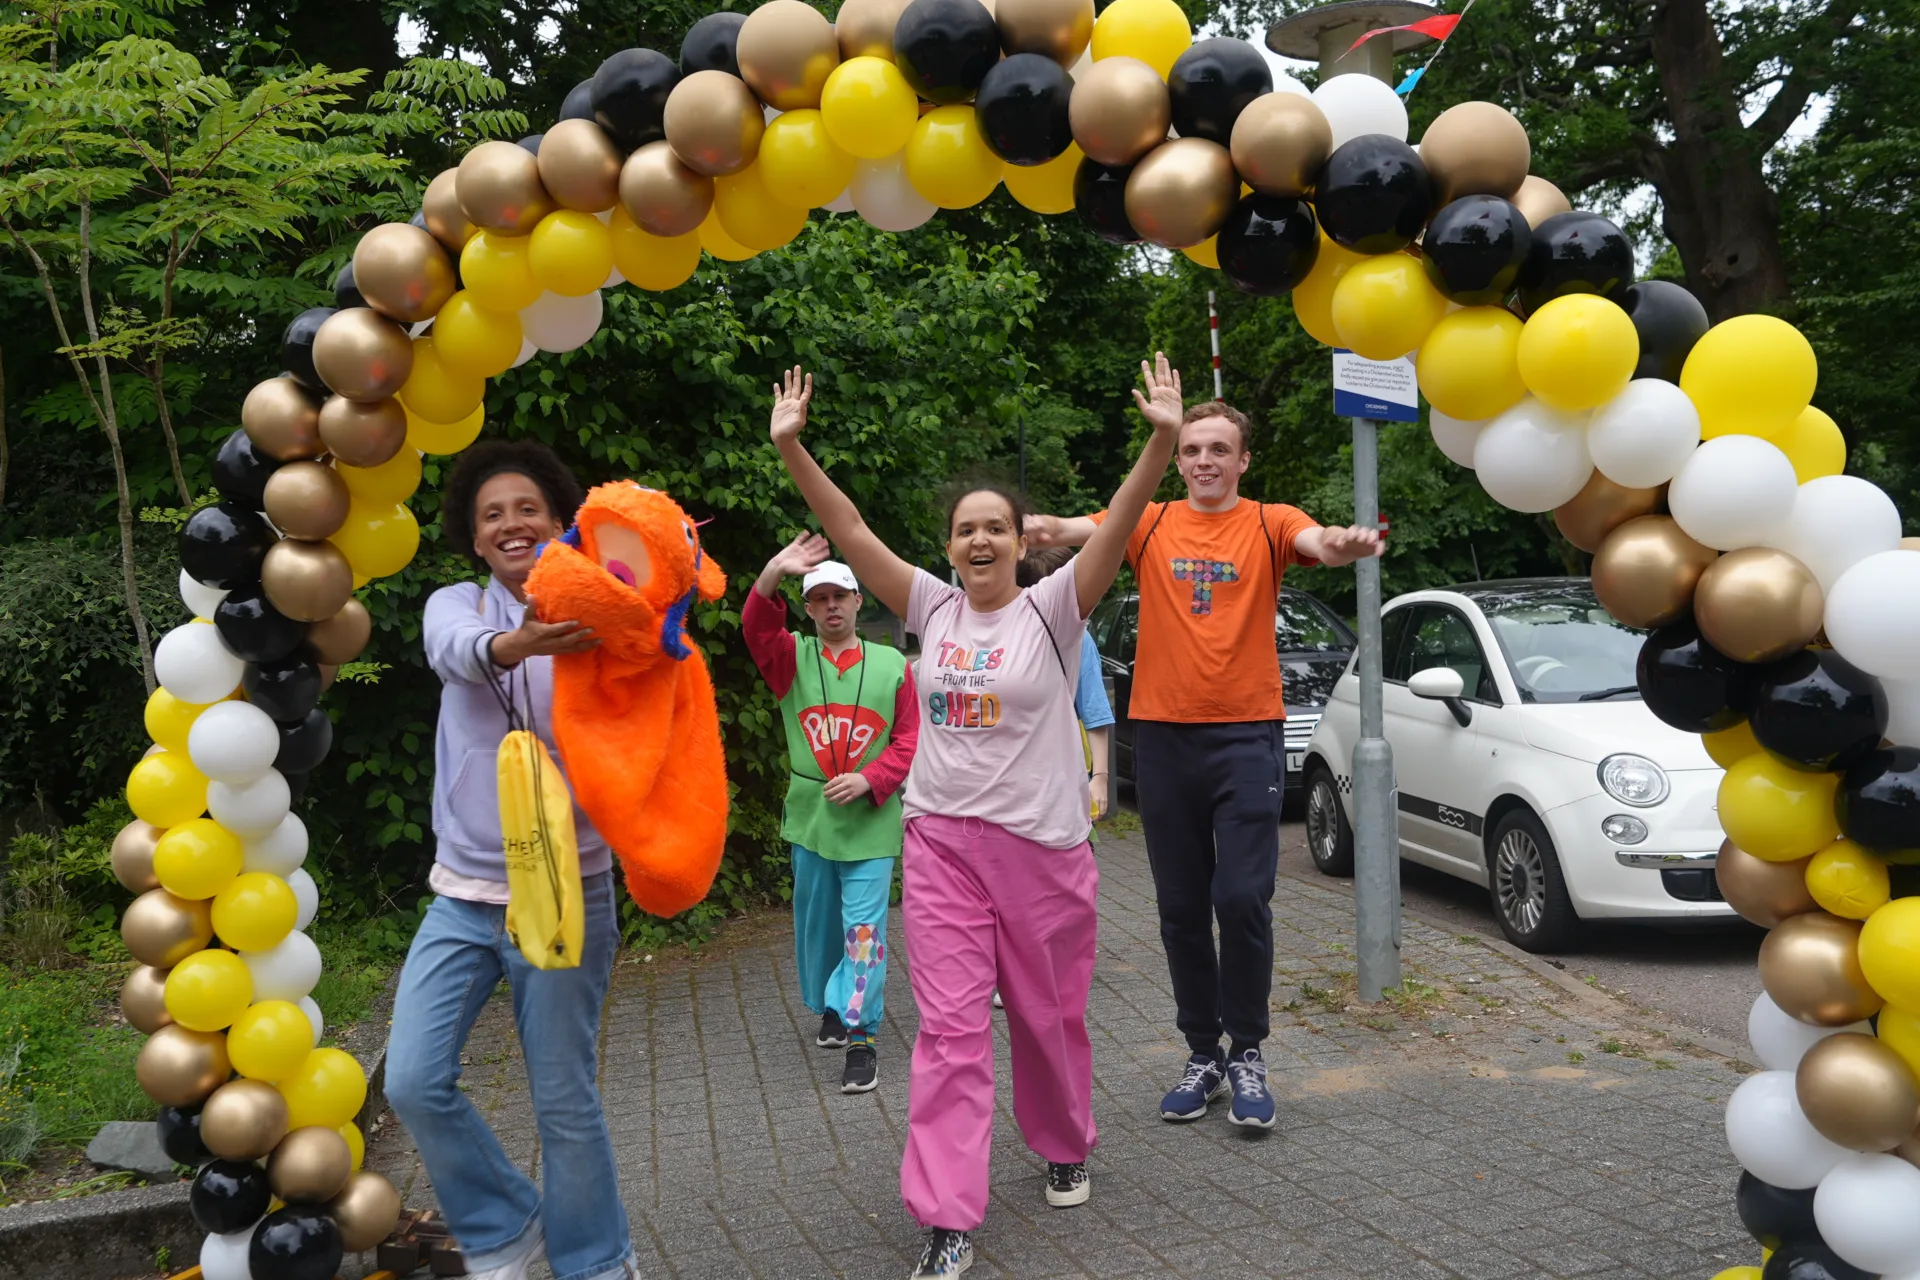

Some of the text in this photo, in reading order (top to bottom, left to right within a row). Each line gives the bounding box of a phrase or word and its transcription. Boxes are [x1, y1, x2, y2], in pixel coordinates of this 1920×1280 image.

[937, 641, 1005, 672] TALES
[942, 673, 986, 687] FROM THE
[928, 691, 1001, 728] SHED
[1438, 805, 1465, 828] 500
